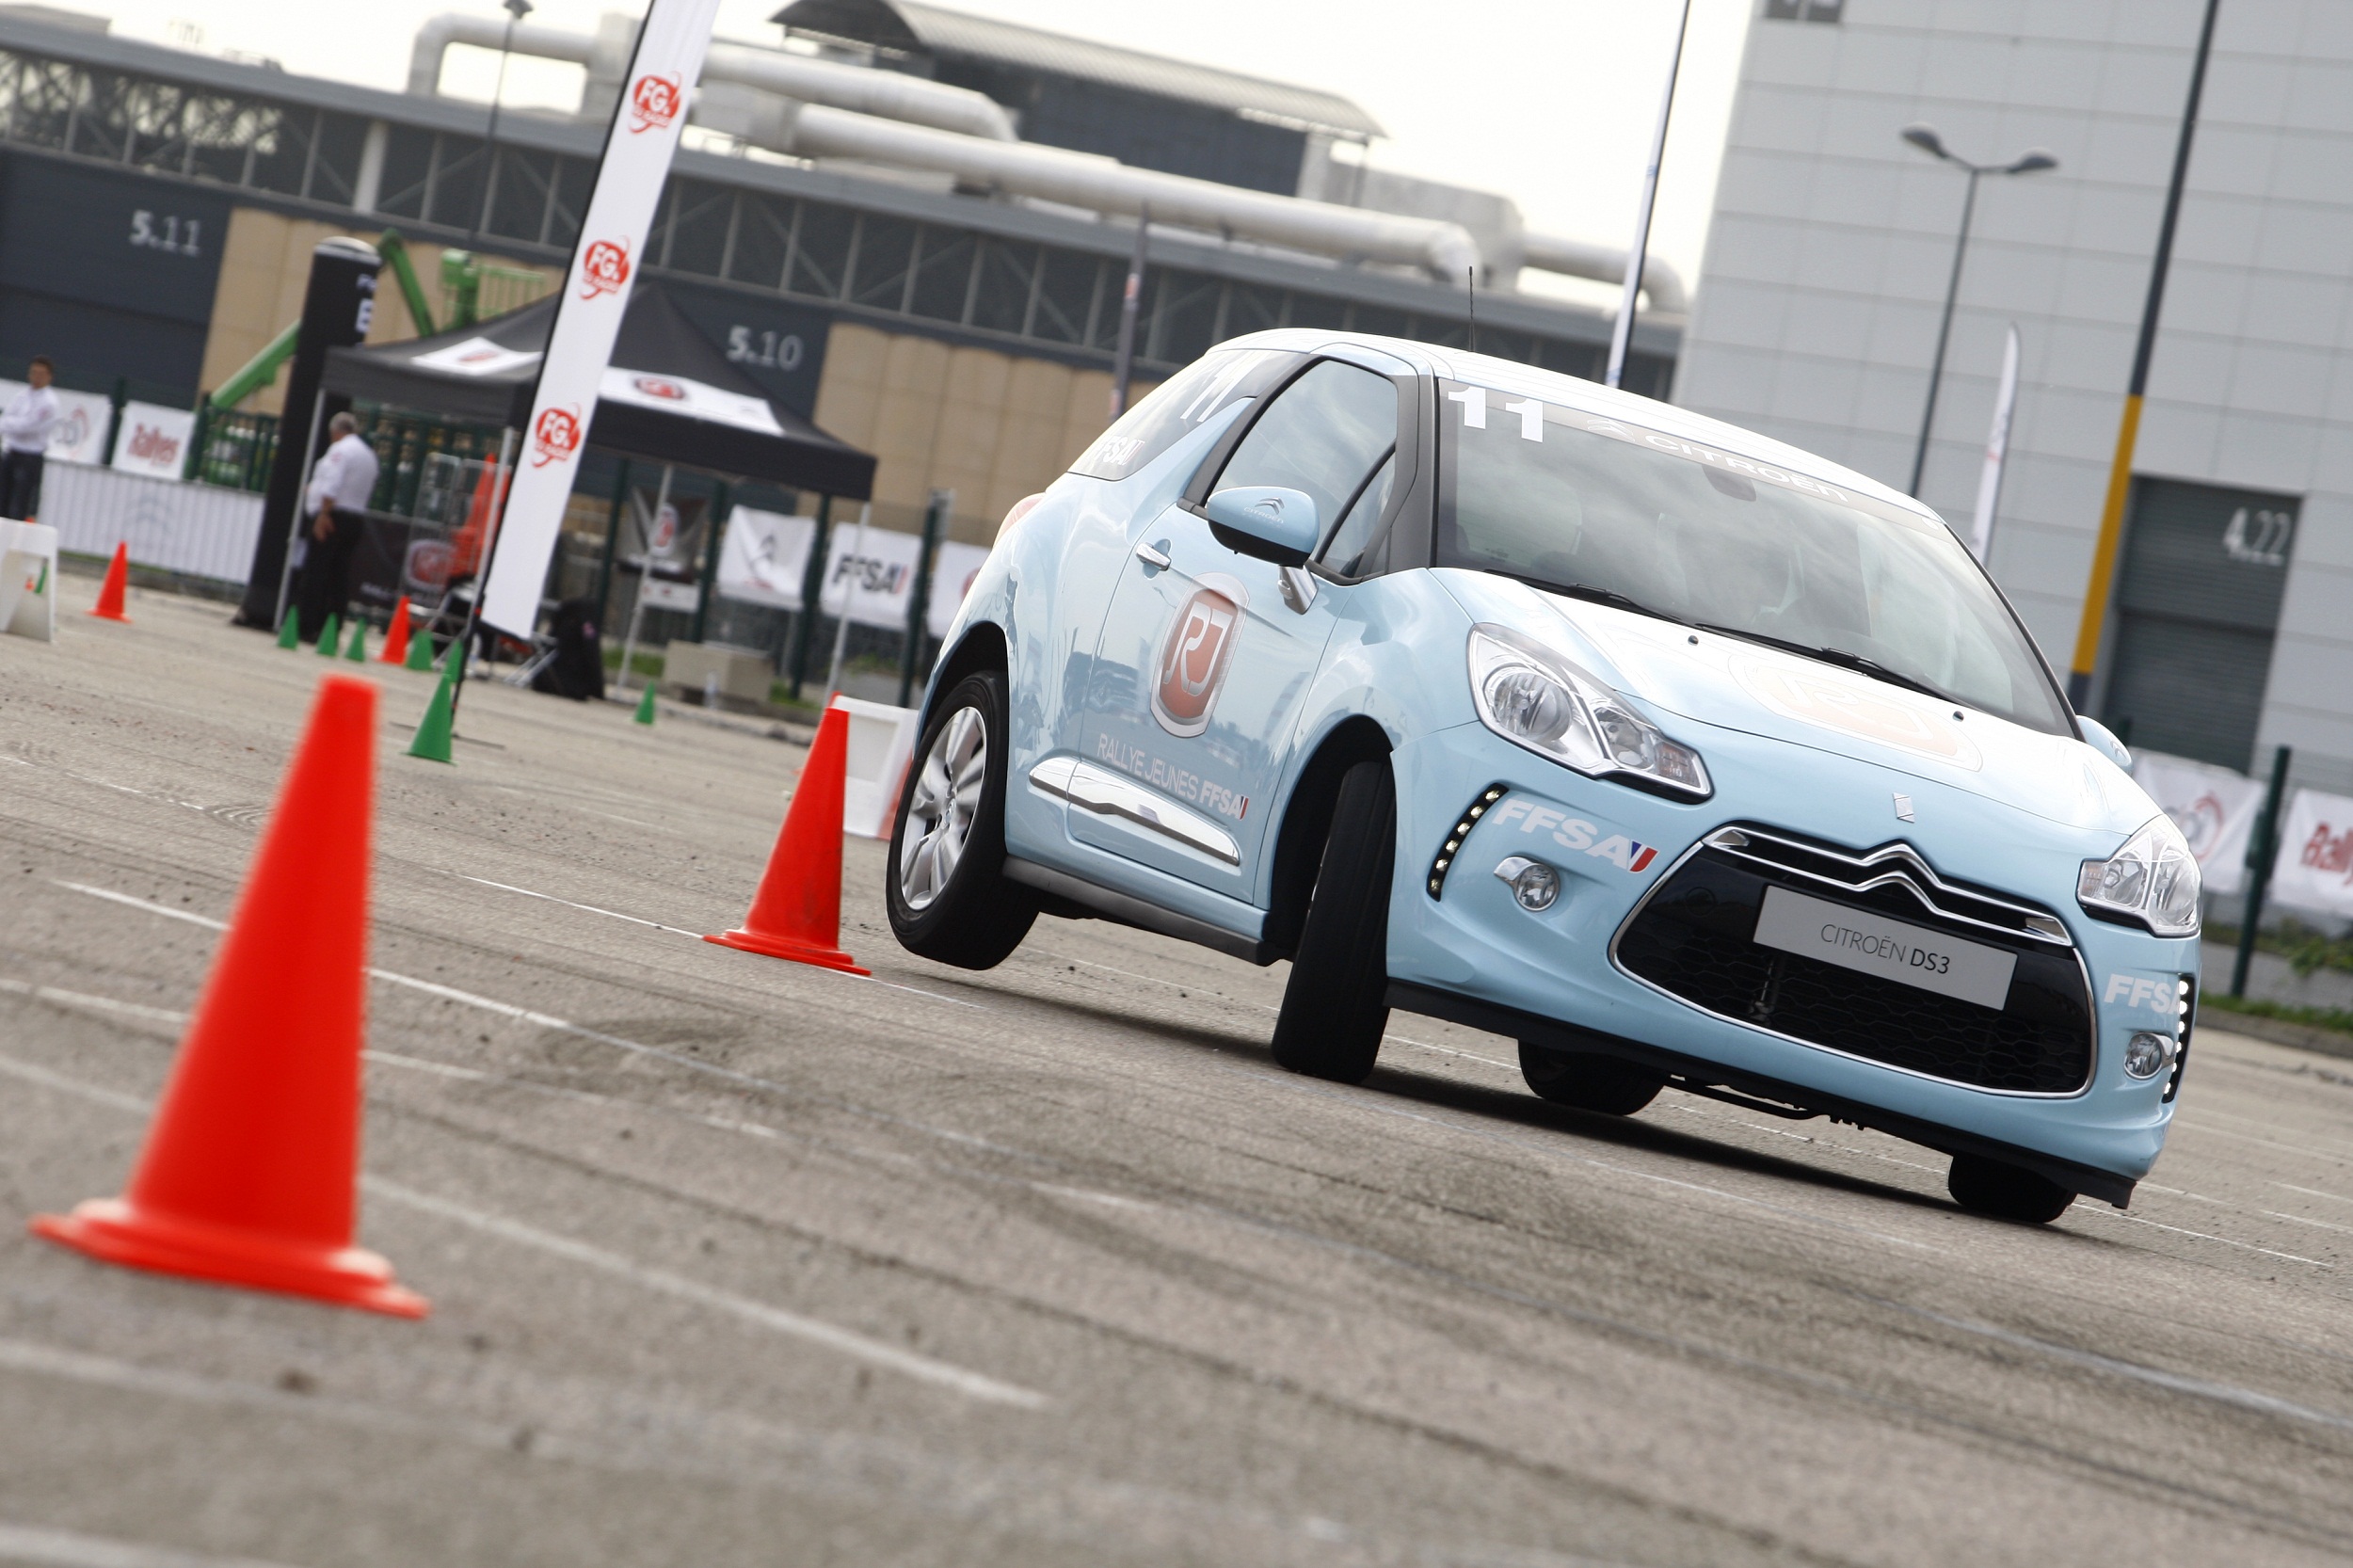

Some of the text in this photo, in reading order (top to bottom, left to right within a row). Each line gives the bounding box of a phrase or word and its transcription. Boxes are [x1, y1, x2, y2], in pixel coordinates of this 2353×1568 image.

[130, 209, 200, 257] 5.11
[726, 325, 803, 371] 5.10
[1449, 386, 1544, 443] 11
[1096, 732, 1244, 819] RALLYE JEUNES FFSA
[1492, 799, 1631, 871] FFSA
[1820, 923, 1950, 974] CITROËN DS3
